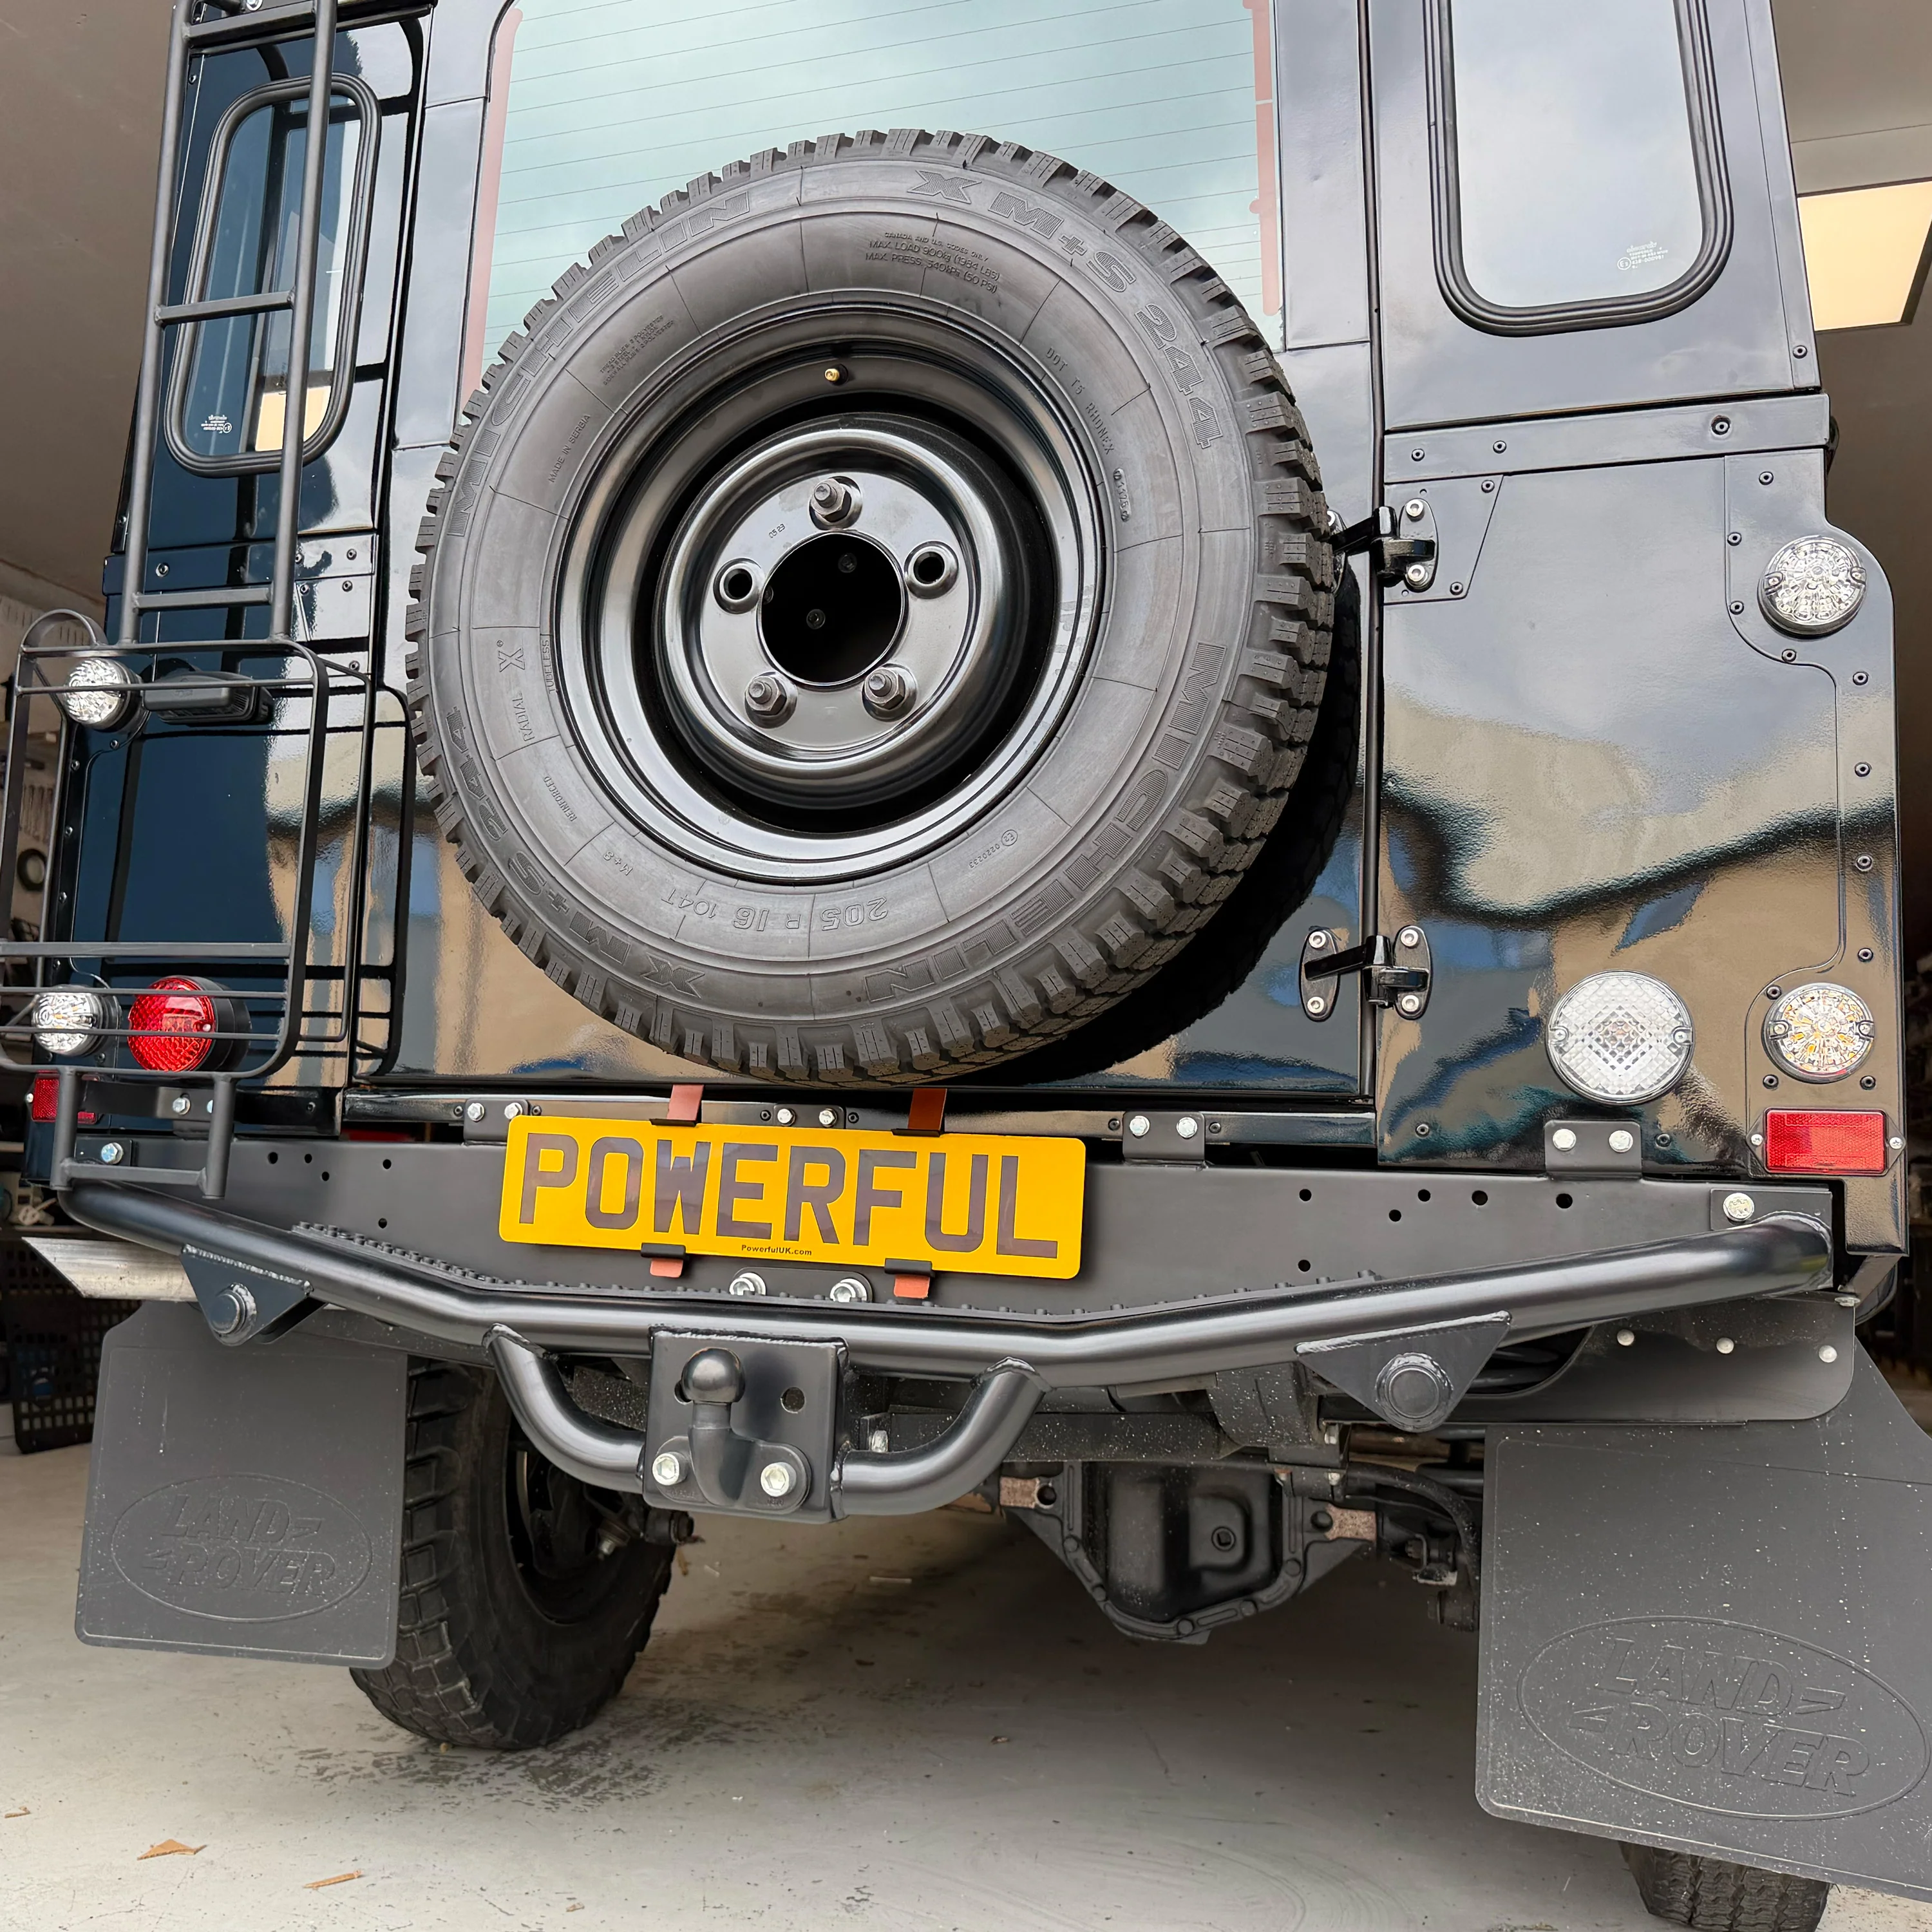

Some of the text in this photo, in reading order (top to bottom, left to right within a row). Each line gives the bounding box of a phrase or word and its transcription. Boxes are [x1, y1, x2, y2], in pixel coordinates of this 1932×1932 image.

[884, 232, 913, 241] CANADA
[946, 243, 969, 254] CODES
[895, 242, 921, 253] LOAD
[922, 246, 952, 263] 900kg
[980, 266, 1000, 282] LBS)
[891, 253, 924, 267] PRESS.
[963, 270, 980, 285] (50
[980, 278, 998, 294] PSI)
[905, 169, 1223, 450] X M+S 244
[446, 191, 751, 537] MICHELIN
[1045, 347, 1068, 372] DOT
[548, 414, 591, 483] MADE IN SERBIA
[768, 523, 786, 538] 05 23
[542, 639, 556, 694] TUBELESS
[512, 691, 536, 742] RADIAL
[543, 776, 578, 822] REINFORCED
[863, 641, 1227, 1003] MICHELIN
[444, 706, 708, 999] X M+S 244
[603, 850, 634, 876] M+S
[969, 843, 1000, 868] 0220233
[660, 887, 890, 932] 205 R 16 104T
[518, 1132, 1059, 1260] POWERFUL
[741, 1244, 812, 1256] PowerfulUK.com
[161, 1493, 292, 1544] LAND
[167, 1543, 336, 1597] ROVER
[1593, 1637, 1794, 1717] LAND
[1613, 1701, 1871, 1797] ROVER
